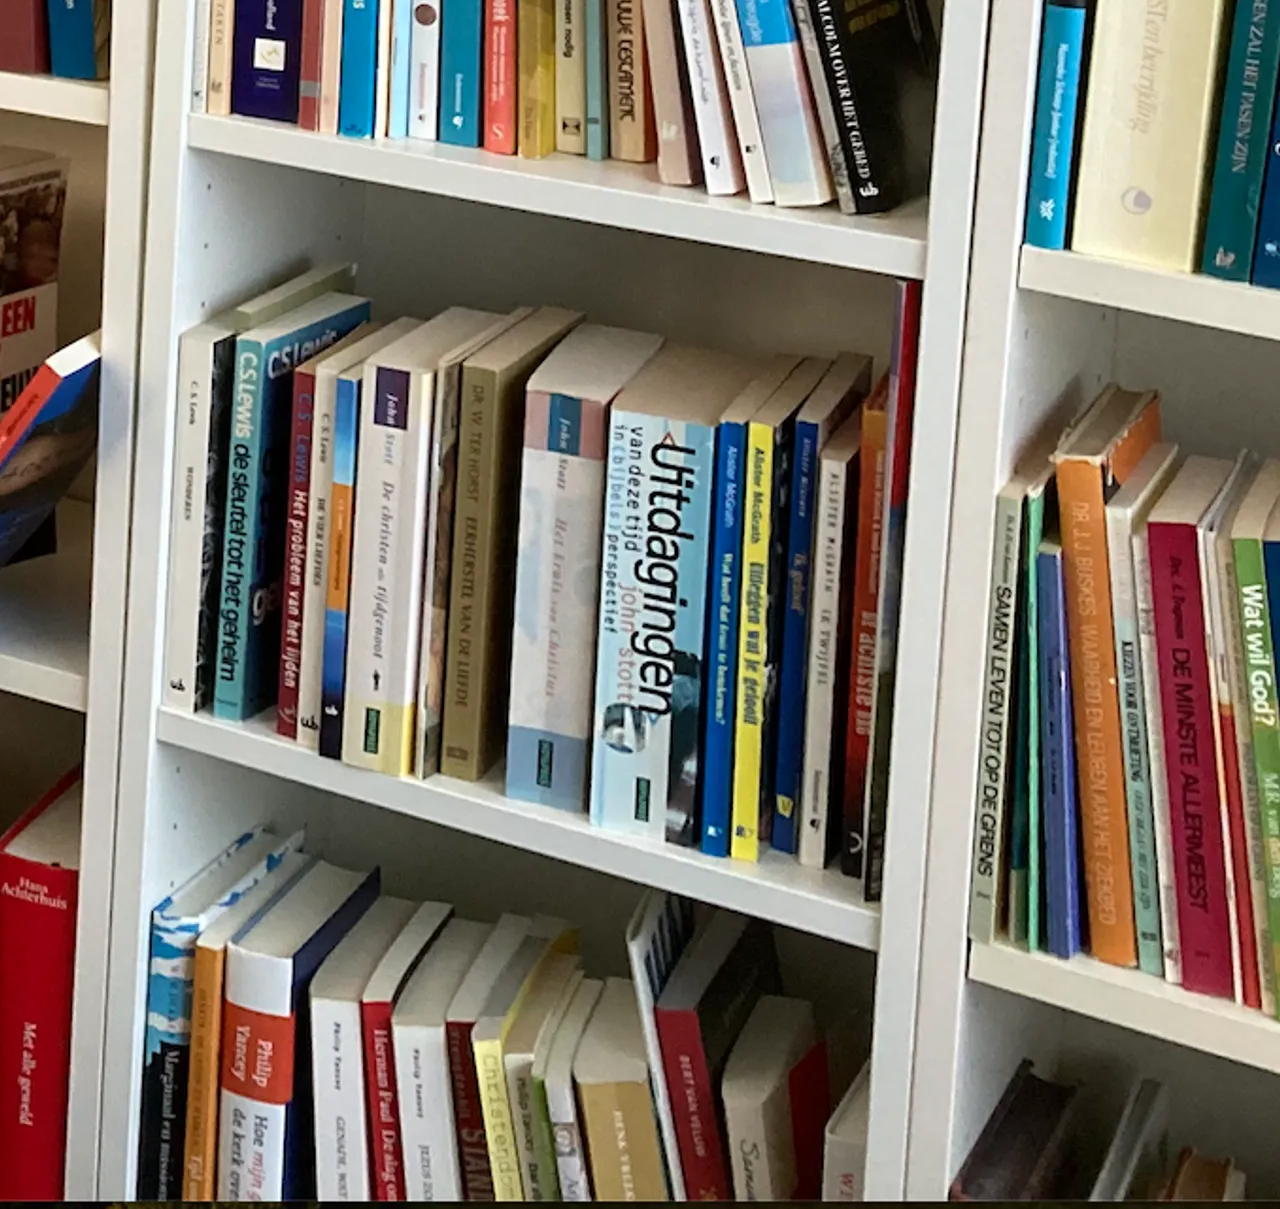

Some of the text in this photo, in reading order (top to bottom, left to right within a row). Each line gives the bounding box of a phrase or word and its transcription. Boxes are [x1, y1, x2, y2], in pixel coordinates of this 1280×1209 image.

[829, 58, 853, 97] OVER
[838, 100, 859, 129] HET
[846, 131, 871, 179] GEBED
[1, 295, 36, 339] EEN
[620, 426, 644, 552] van deze tijd
[219, 443, 253, 681] de sleutel tot het geheim
[282, 489, 308, 688] Het probleem van het lijden
[631, 443, 696, 718] Uitdagingen
[1240, 584, 1275, 726] Wat wil God?
[978, 584, 1012, 876] SAMEN LEVEN TOT OP DE GRENS
[1171, 648, 1209, 912] DE MINSTE ALLERMEEST
[0, 882, 68, 910] Achterhuis
[19, 876, 49, 893] Hans
[17, 1022, 37, 1127] Met alle geweld
[230, 1025, 249, 1081] Yancey
[253, 1038, 273, 1087] Philip
